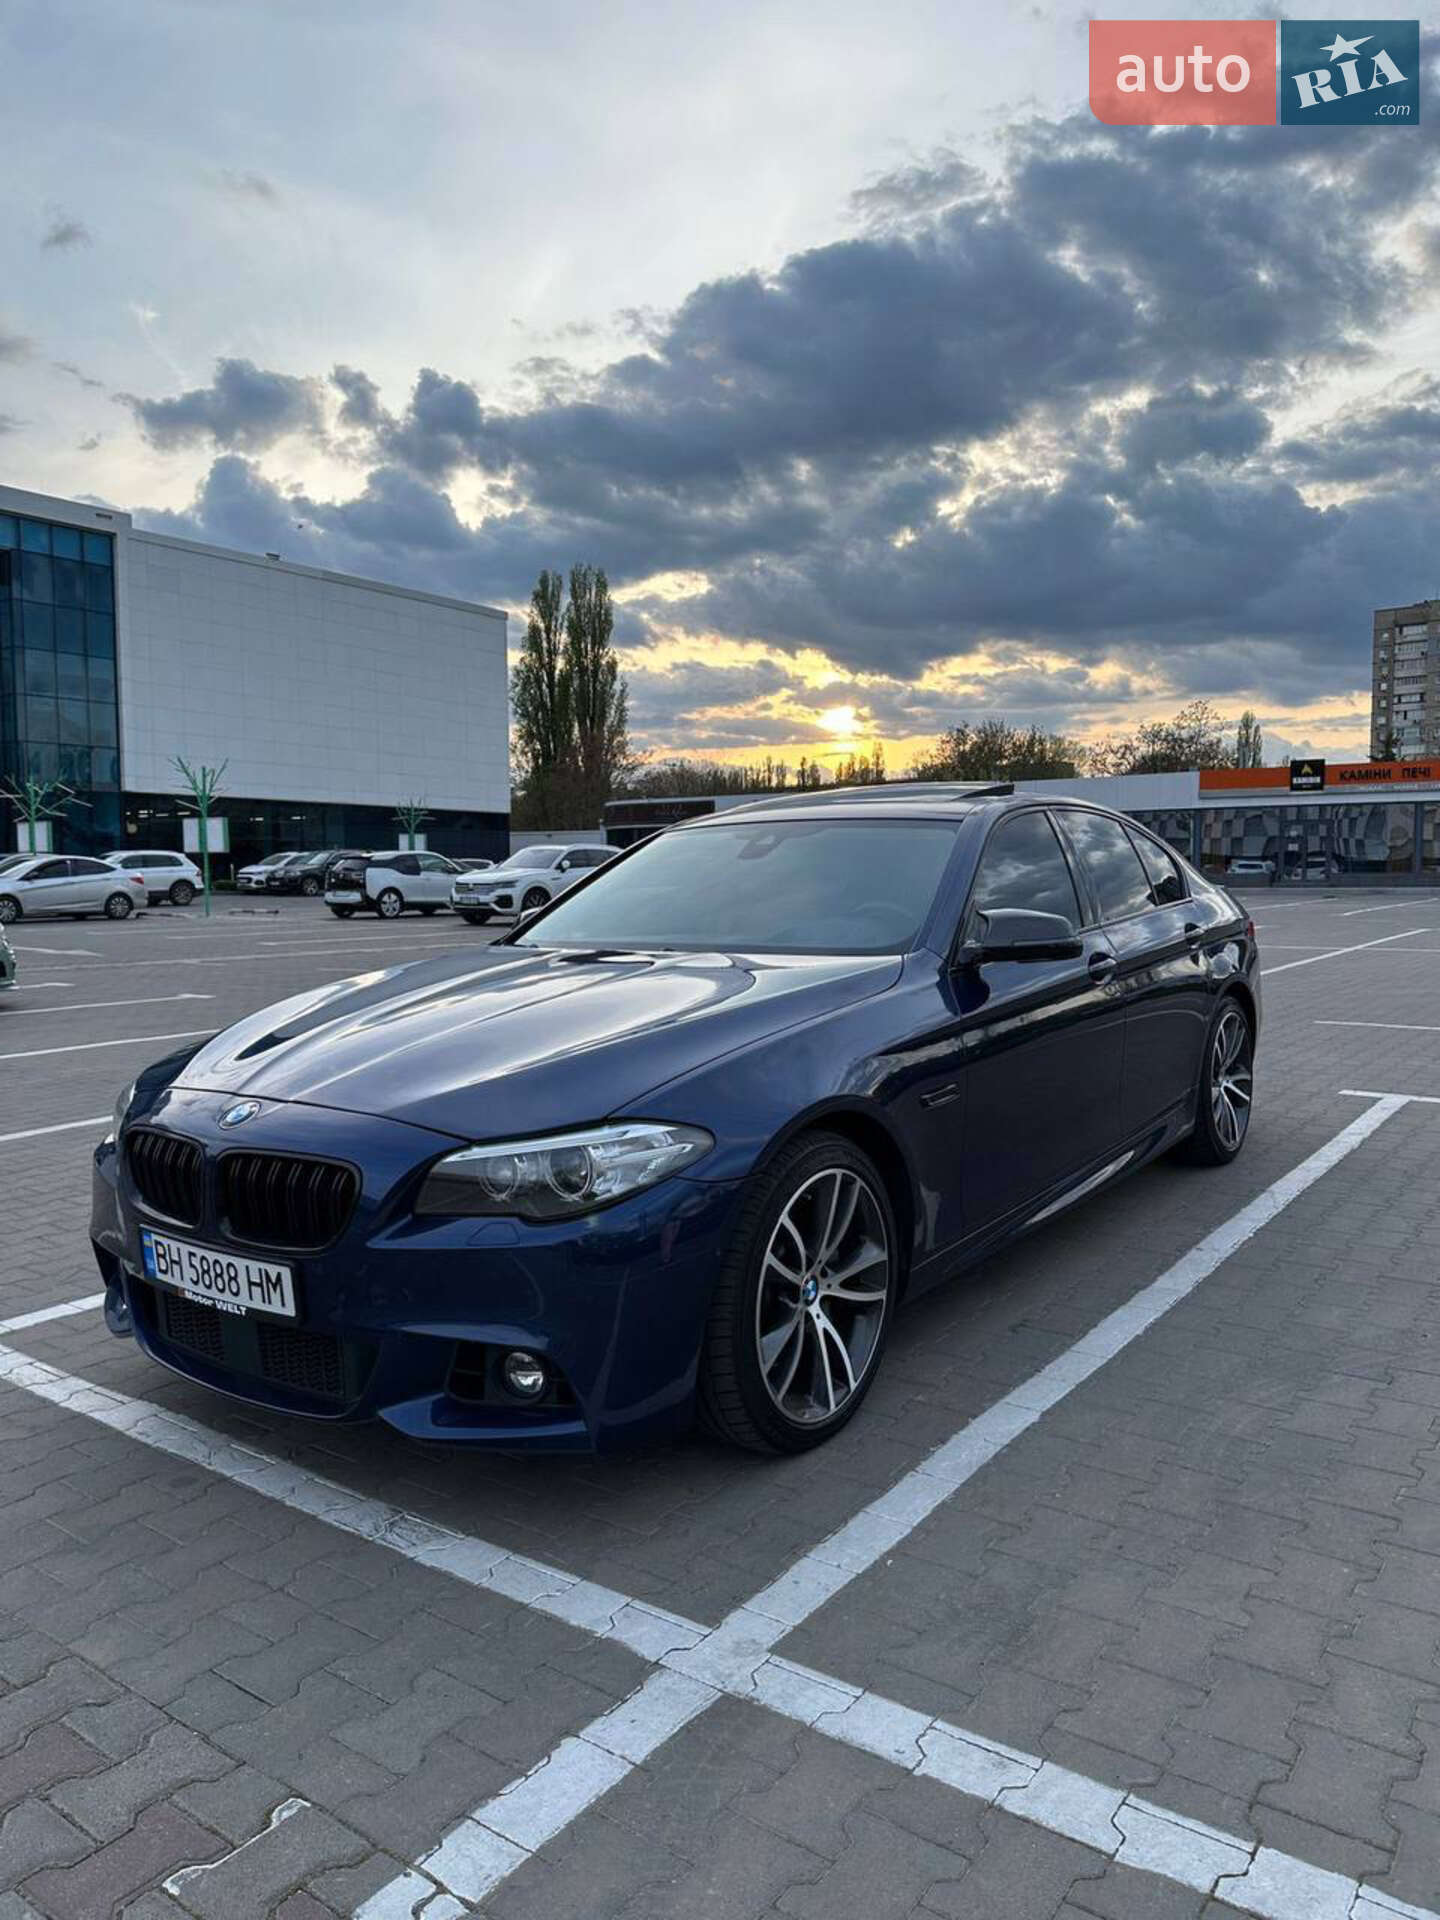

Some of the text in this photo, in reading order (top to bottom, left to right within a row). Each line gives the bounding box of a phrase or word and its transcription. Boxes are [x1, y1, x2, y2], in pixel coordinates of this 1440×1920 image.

[1340, 767, 1431, 781] КАМІНИ ПЕЧІ
[154, 1240, 184, 1281] BH
[188, 1251, 241, 1297] 5888
[246, 1265, 286, 1307] HM
[215, 1300, 247, 1316] WELT
